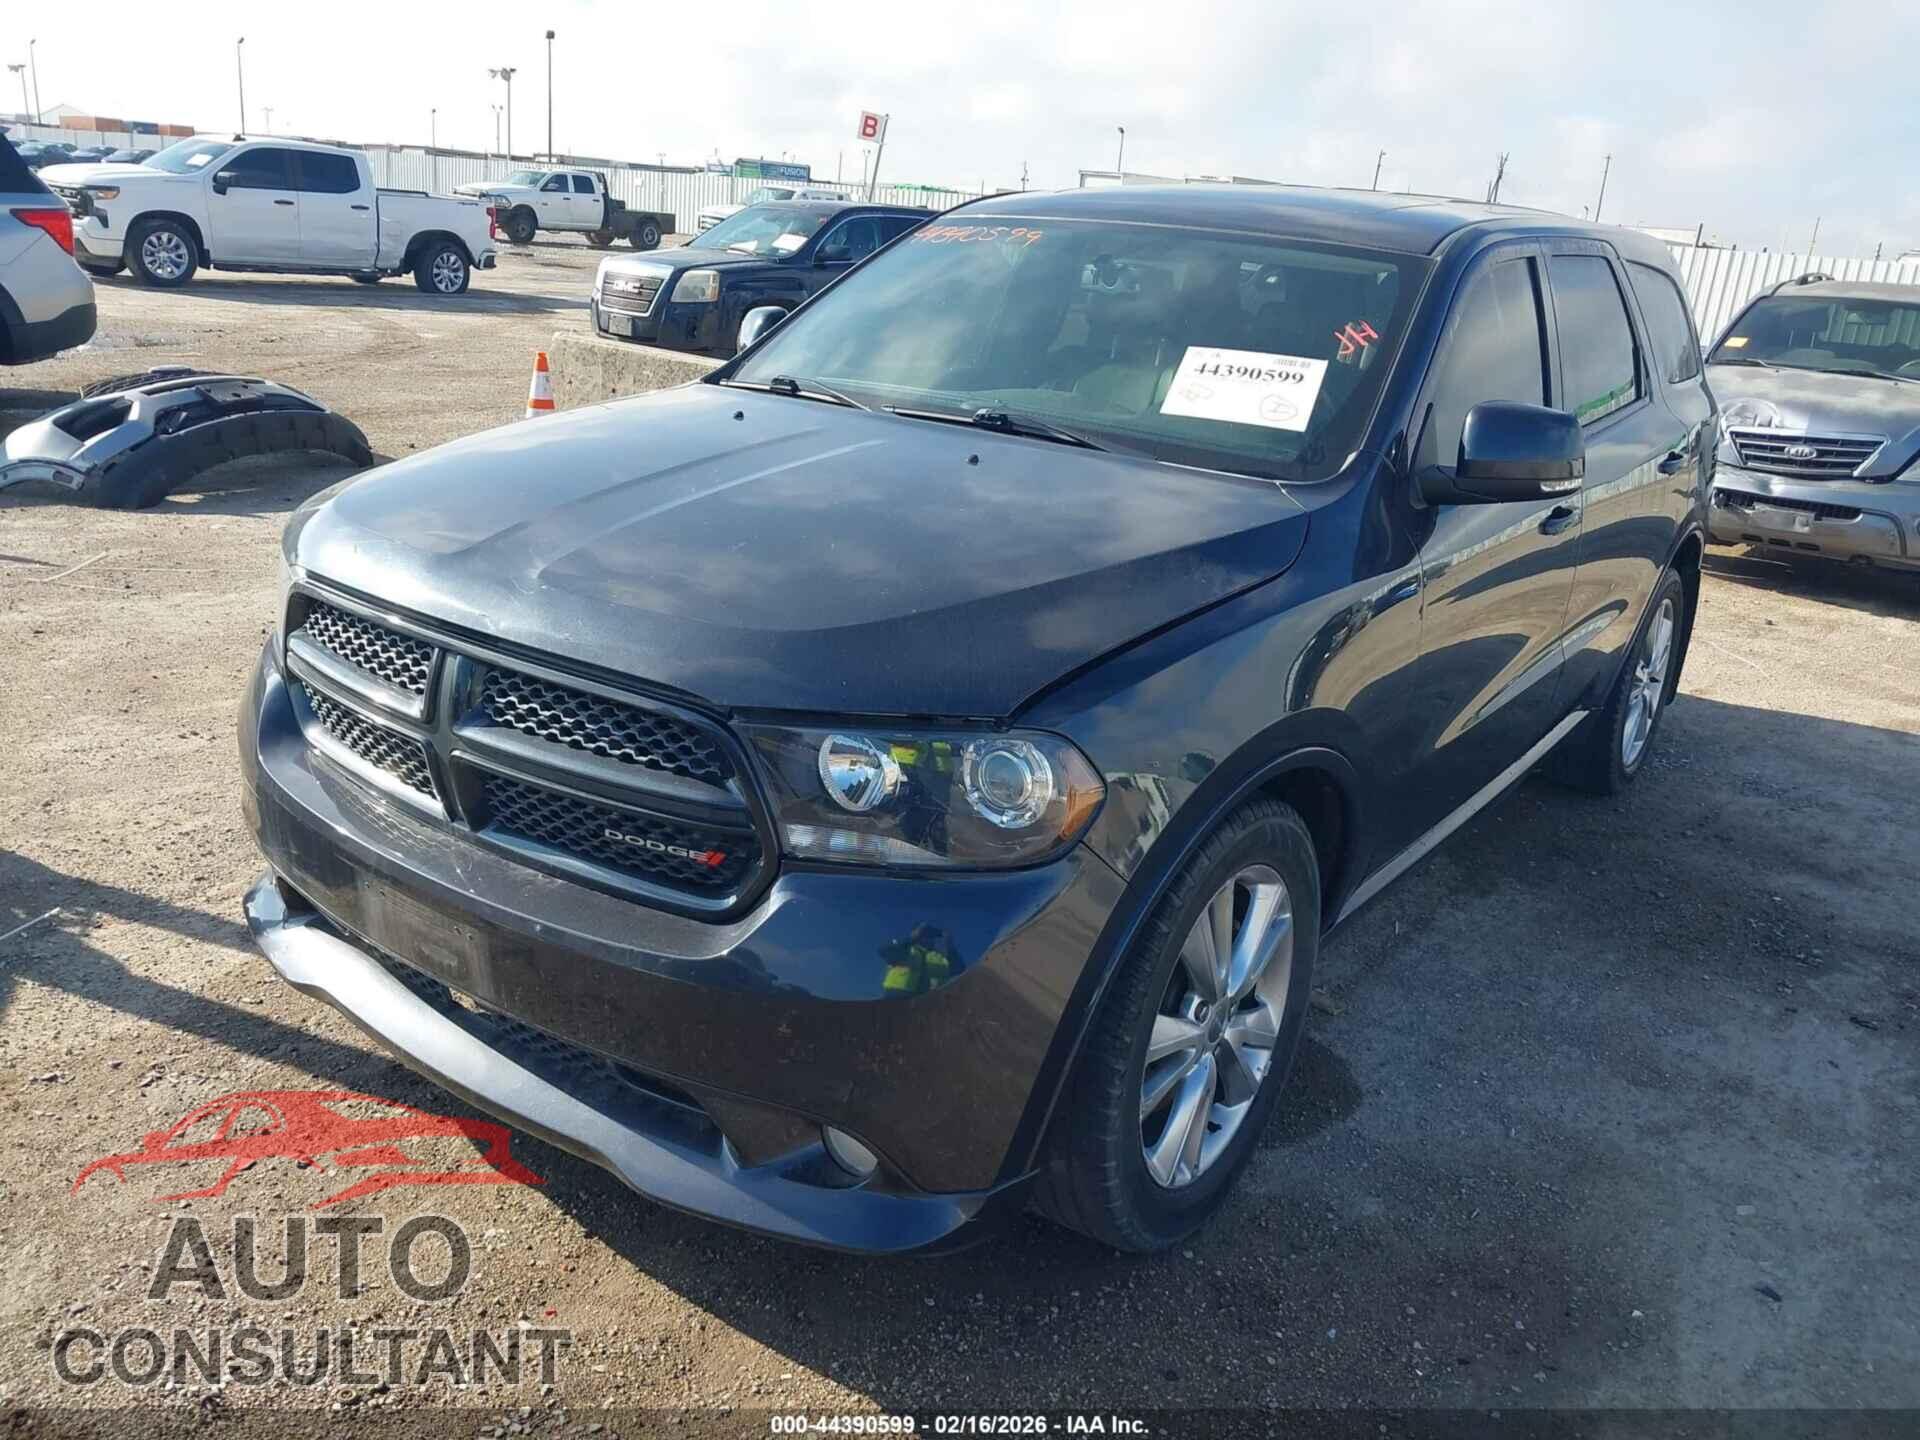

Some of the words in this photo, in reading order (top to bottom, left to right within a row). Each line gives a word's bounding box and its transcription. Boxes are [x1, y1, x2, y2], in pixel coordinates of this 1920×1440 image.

[862, 115, 878, 137] B
[1193, 362, 1304, 384] 44390599
[604, 829, 708, 862] DODGE
